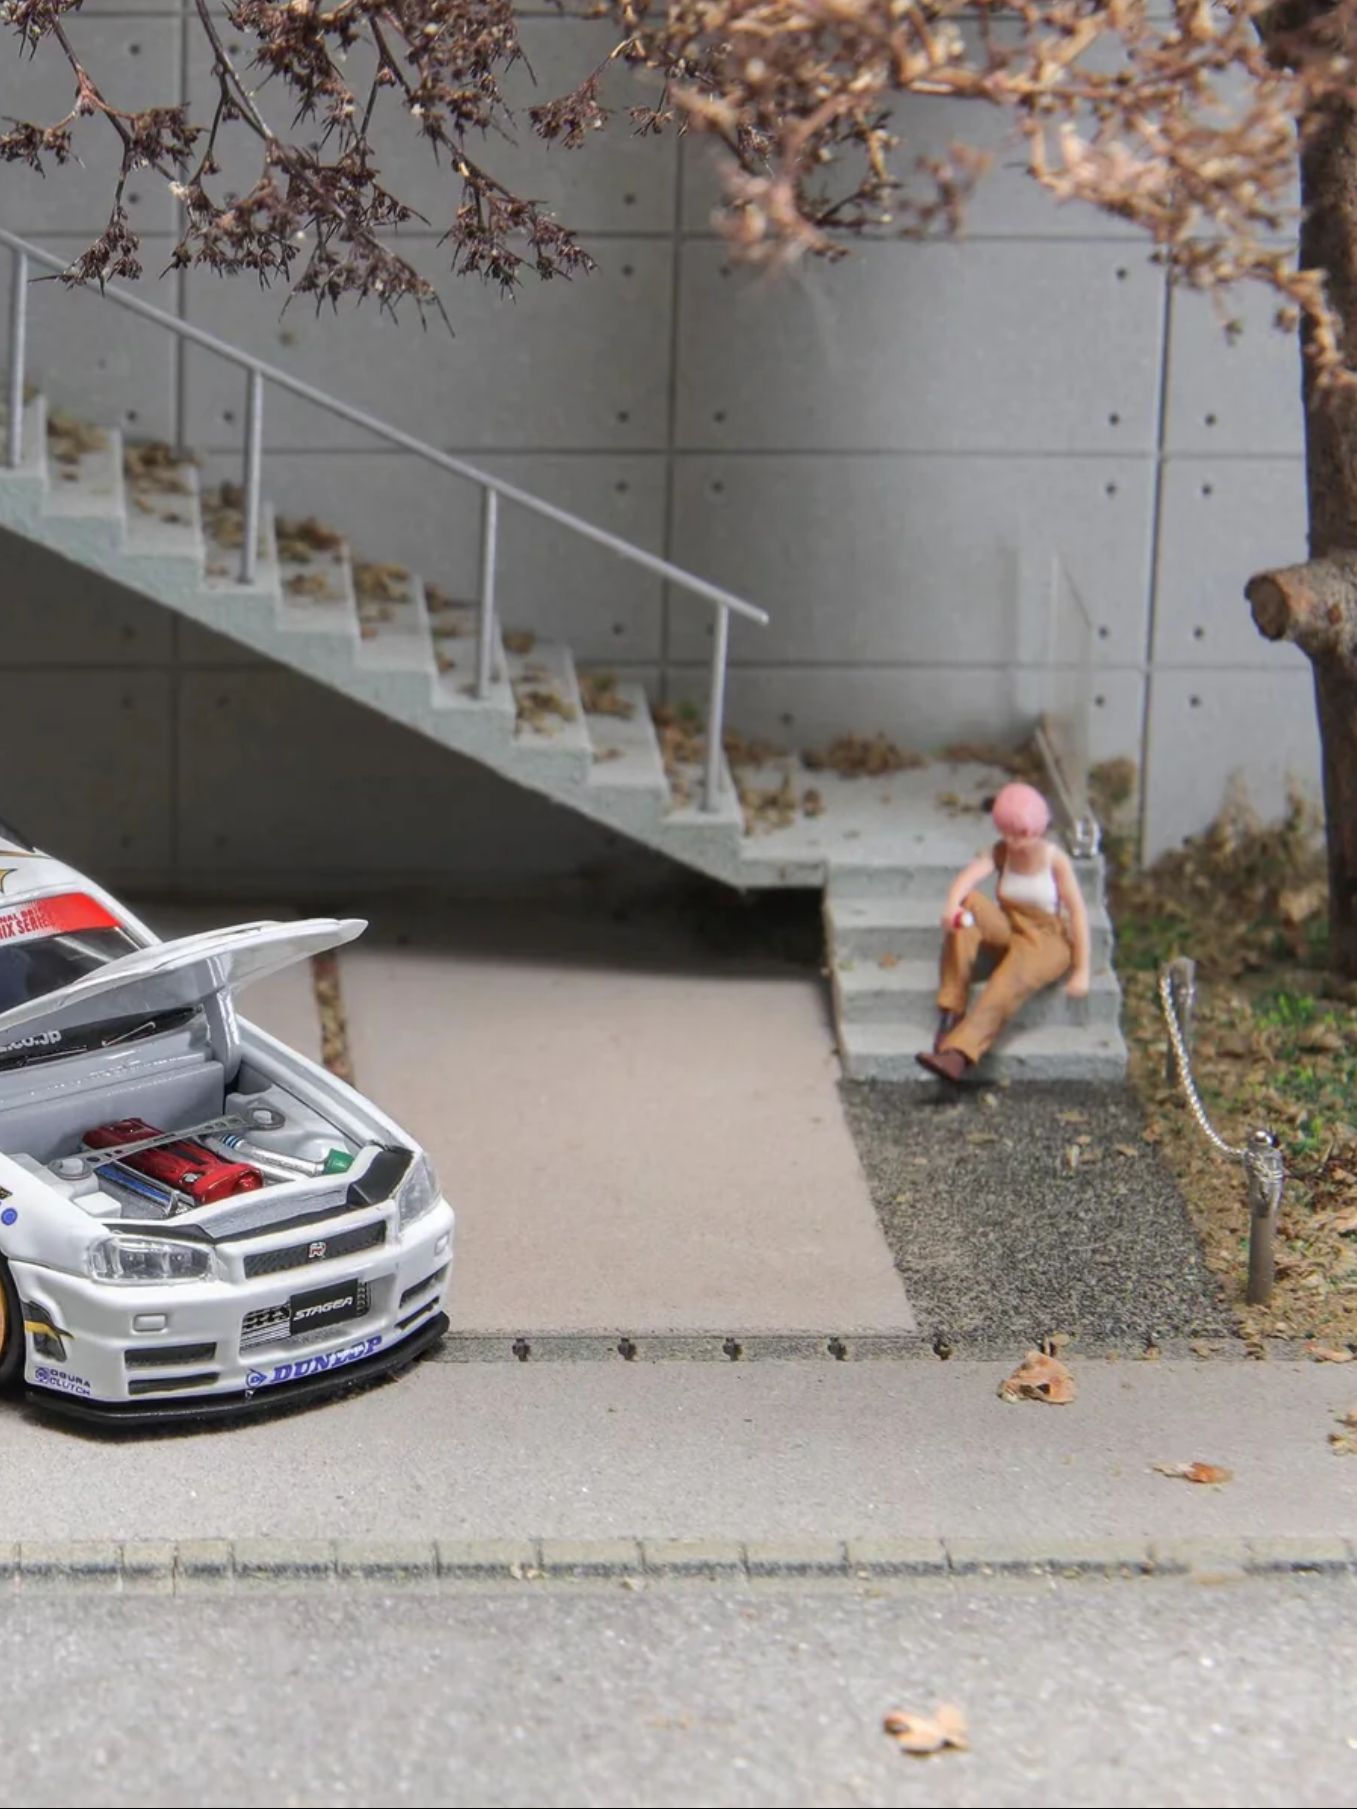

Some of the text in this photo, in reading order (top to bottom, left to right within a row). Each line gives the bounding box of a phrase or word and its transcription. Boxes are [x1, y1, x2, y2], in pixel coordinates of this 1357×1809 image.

[293, 1296, 354, 1321] STAGEA
[270, 1335, 383, 1383] DUNLOP
[49, 1377, 91, 1396] CLUTCH
